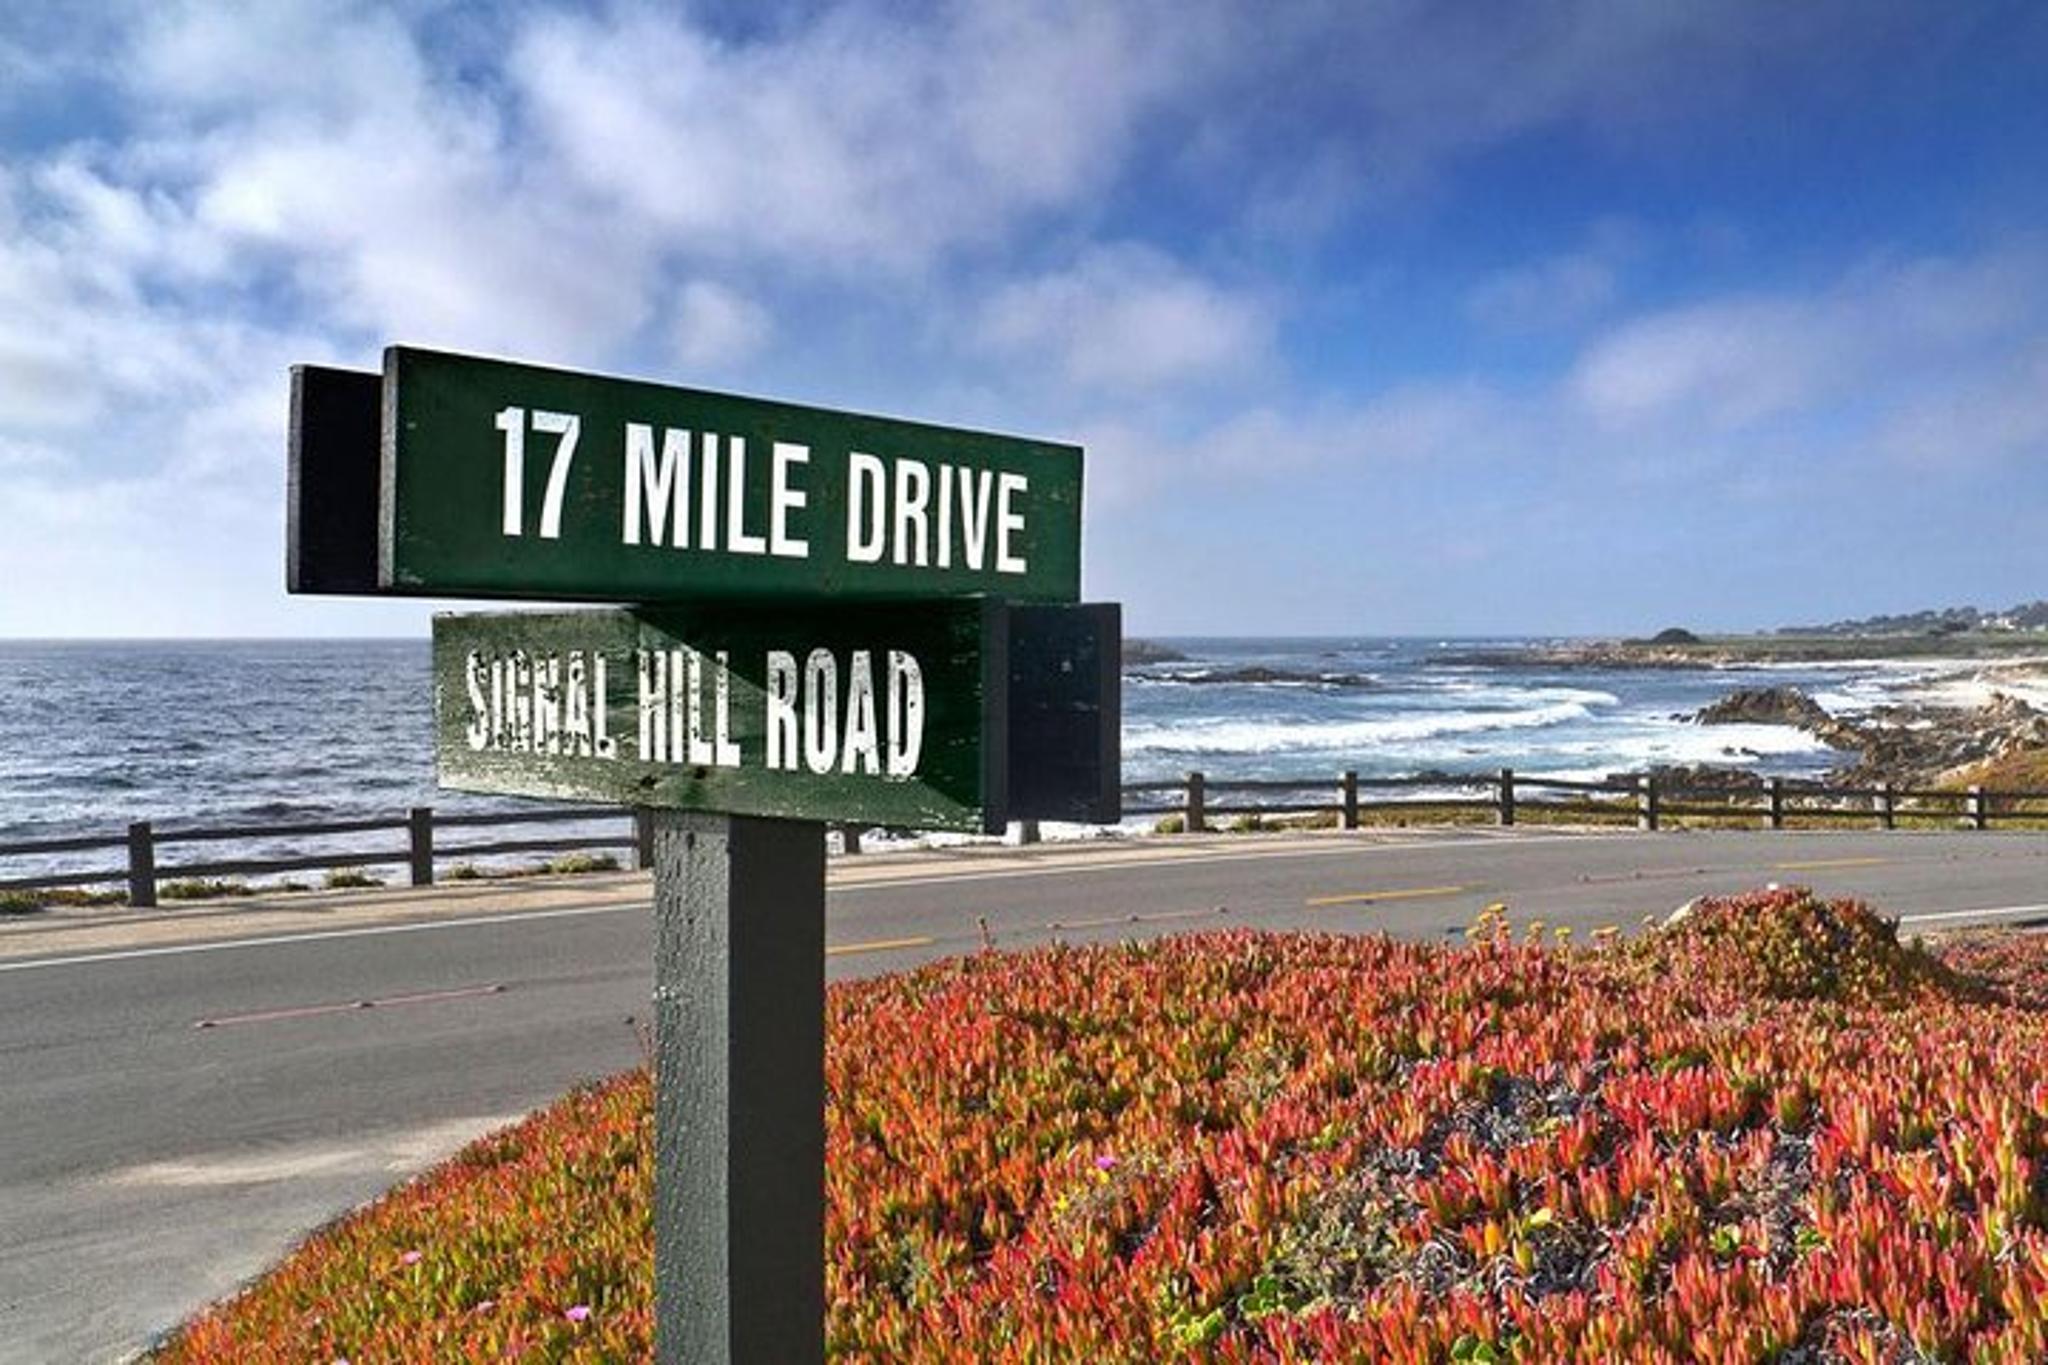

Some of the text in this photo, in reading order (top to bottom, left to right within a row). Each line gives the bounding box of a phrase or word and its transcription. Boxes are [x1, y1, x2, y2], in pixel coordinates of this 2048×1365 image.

[495, 406, 1028, 573] 17 MILE DRIVE
[465, 648, 925, 779] SIGNAL HILL ROAD
